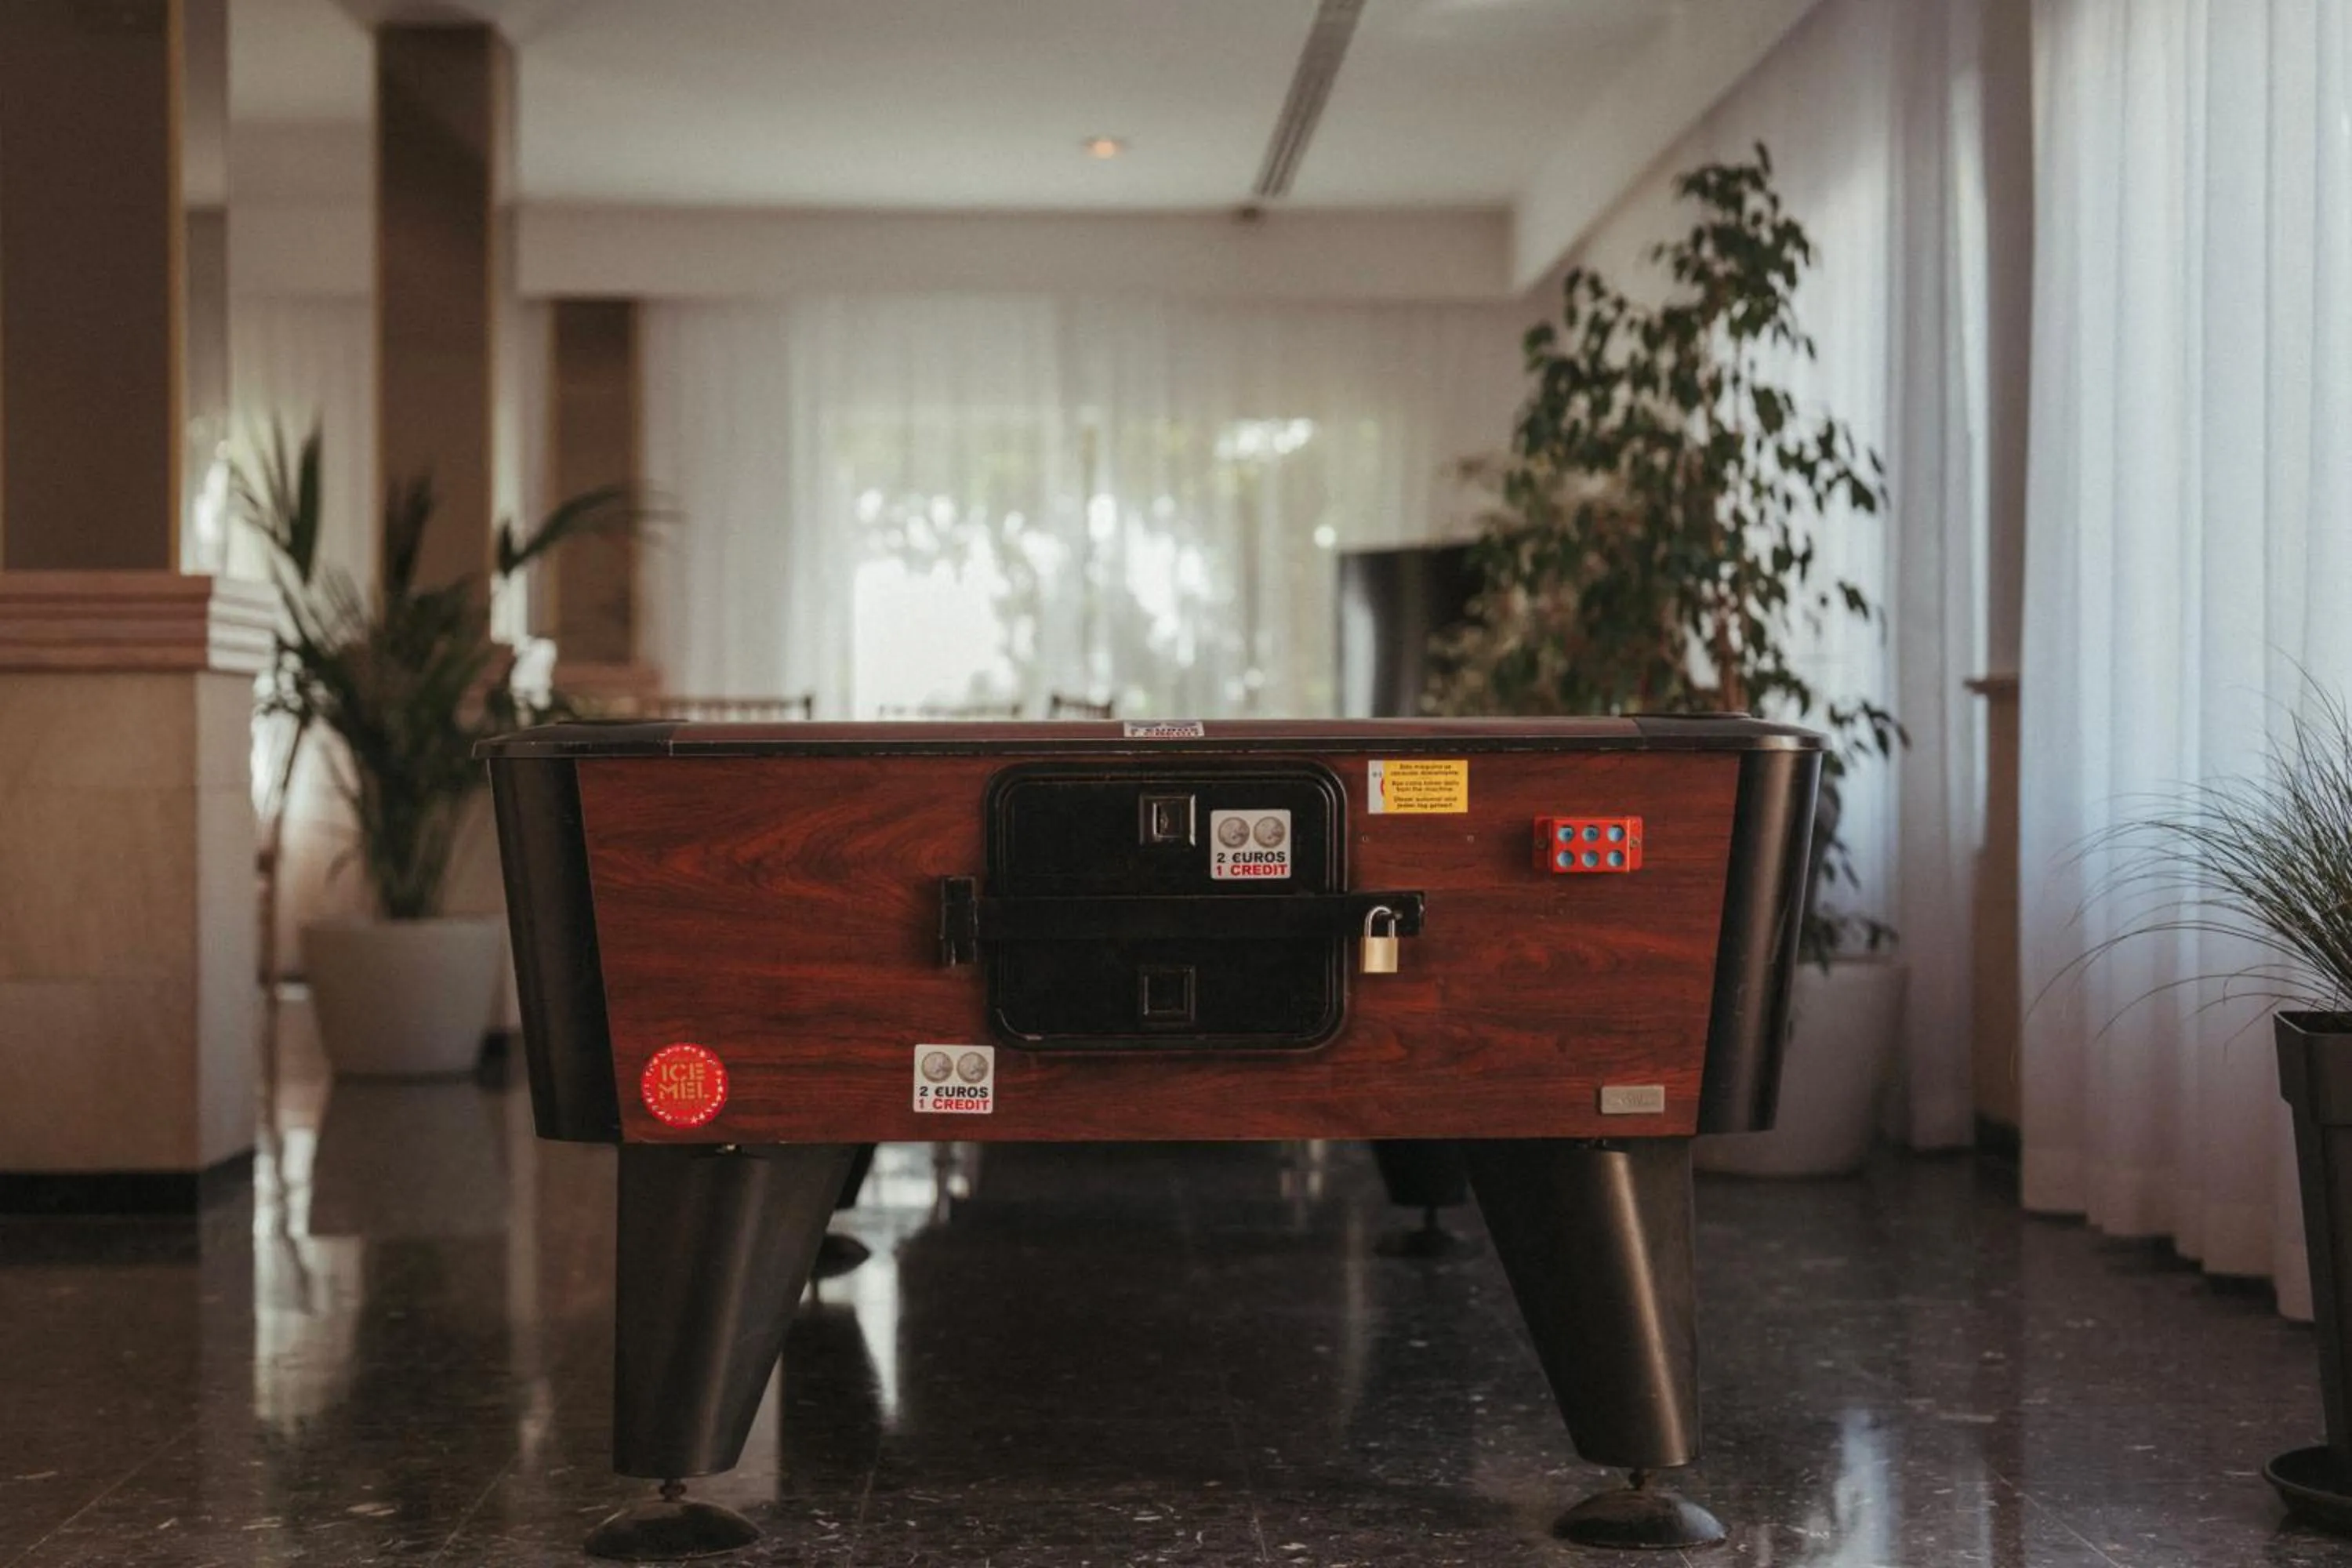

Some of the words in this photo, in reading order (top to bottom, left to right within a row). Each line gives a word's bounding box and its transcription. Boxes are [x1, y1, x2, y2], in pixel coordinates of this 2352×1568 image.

[1217, 852, 1226, 863] 2
[1216, 865, 1223, 876] 1
[1230, 864, 1288, 877] CREDIT
[661, 1062, 706, 1082] ICE
[919, 1086, 929, 1097] 2
[918, 1098, 925, 1109] 1
[932, 1098, 991, 1111] CREDIT
